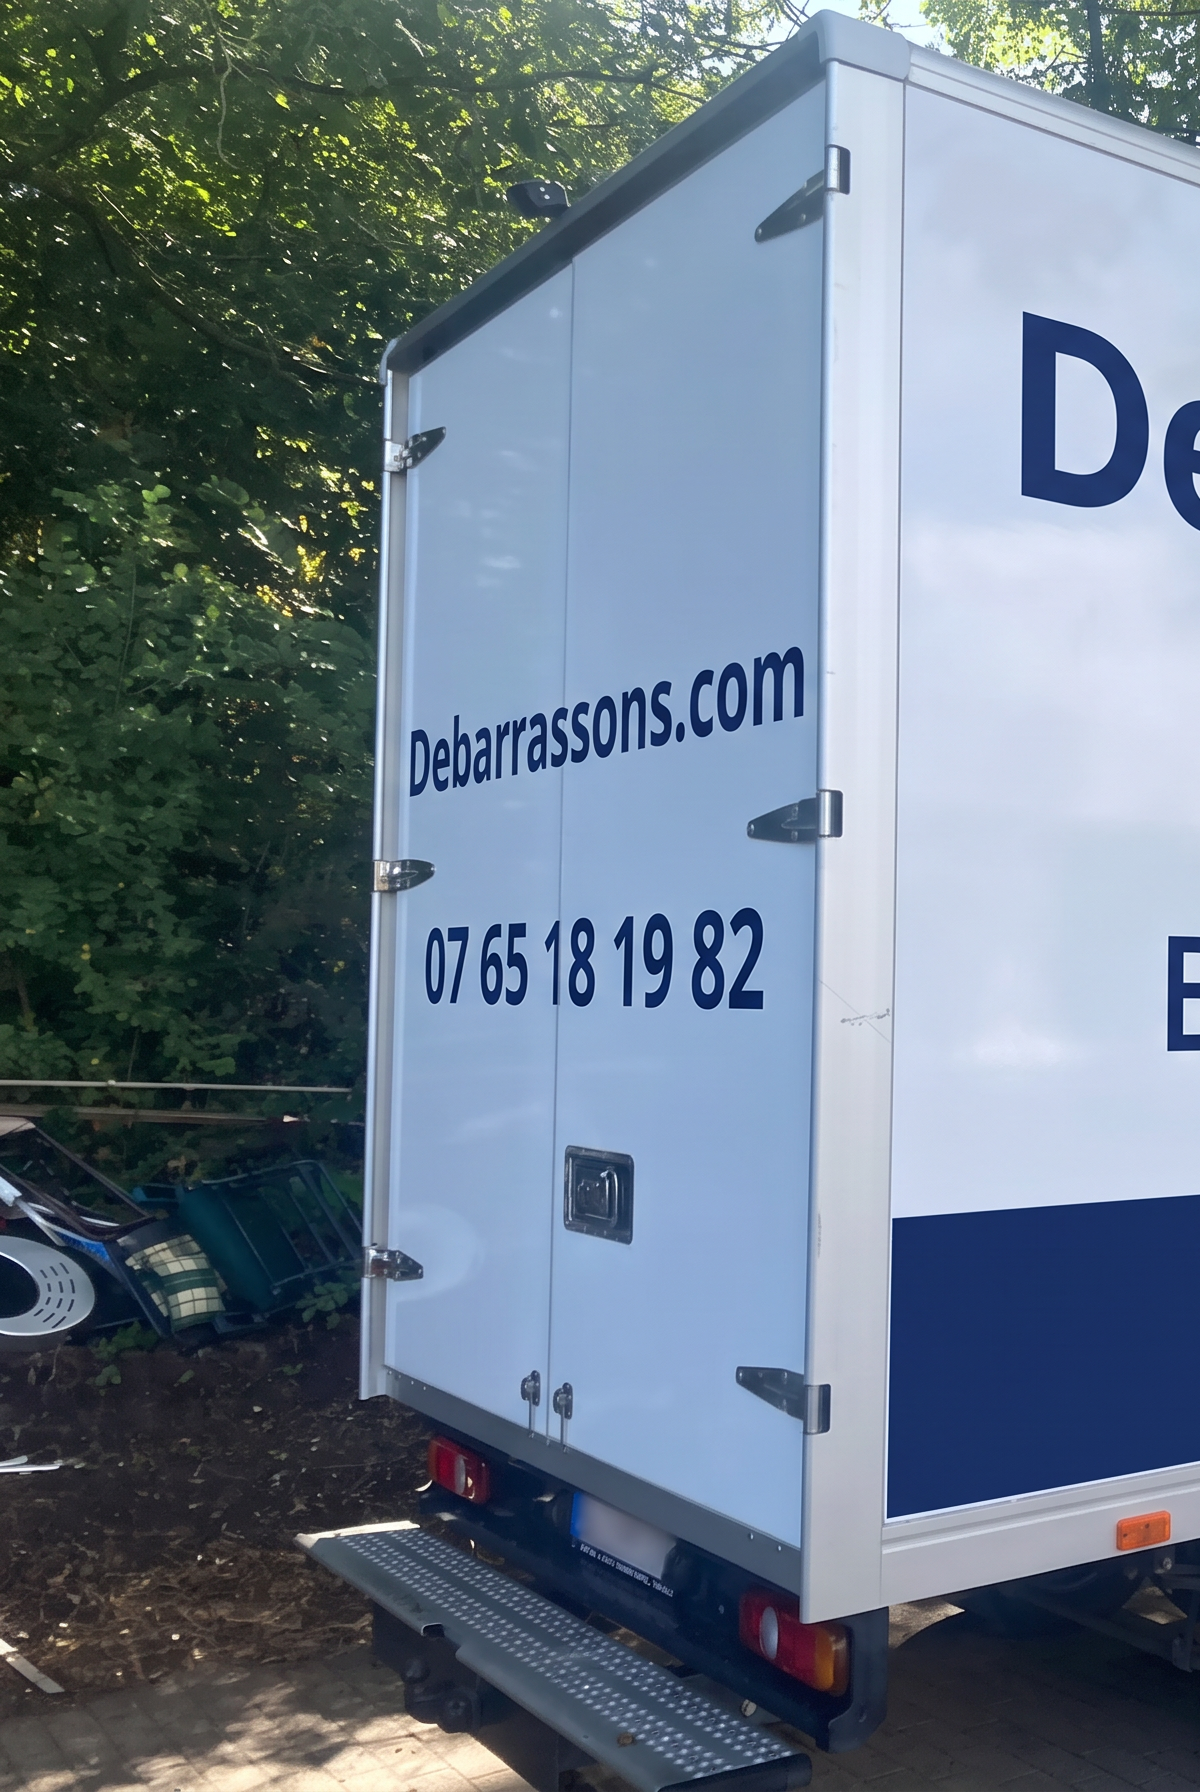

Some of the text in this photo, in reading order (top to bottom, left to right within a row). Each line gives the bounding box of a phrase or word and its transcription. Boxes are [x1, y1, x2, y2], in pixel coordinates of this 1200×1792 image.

[409, 645, 805, 798] Debarrassons.com
[424, 906, 764, 1011] 07 65 18 19 82
